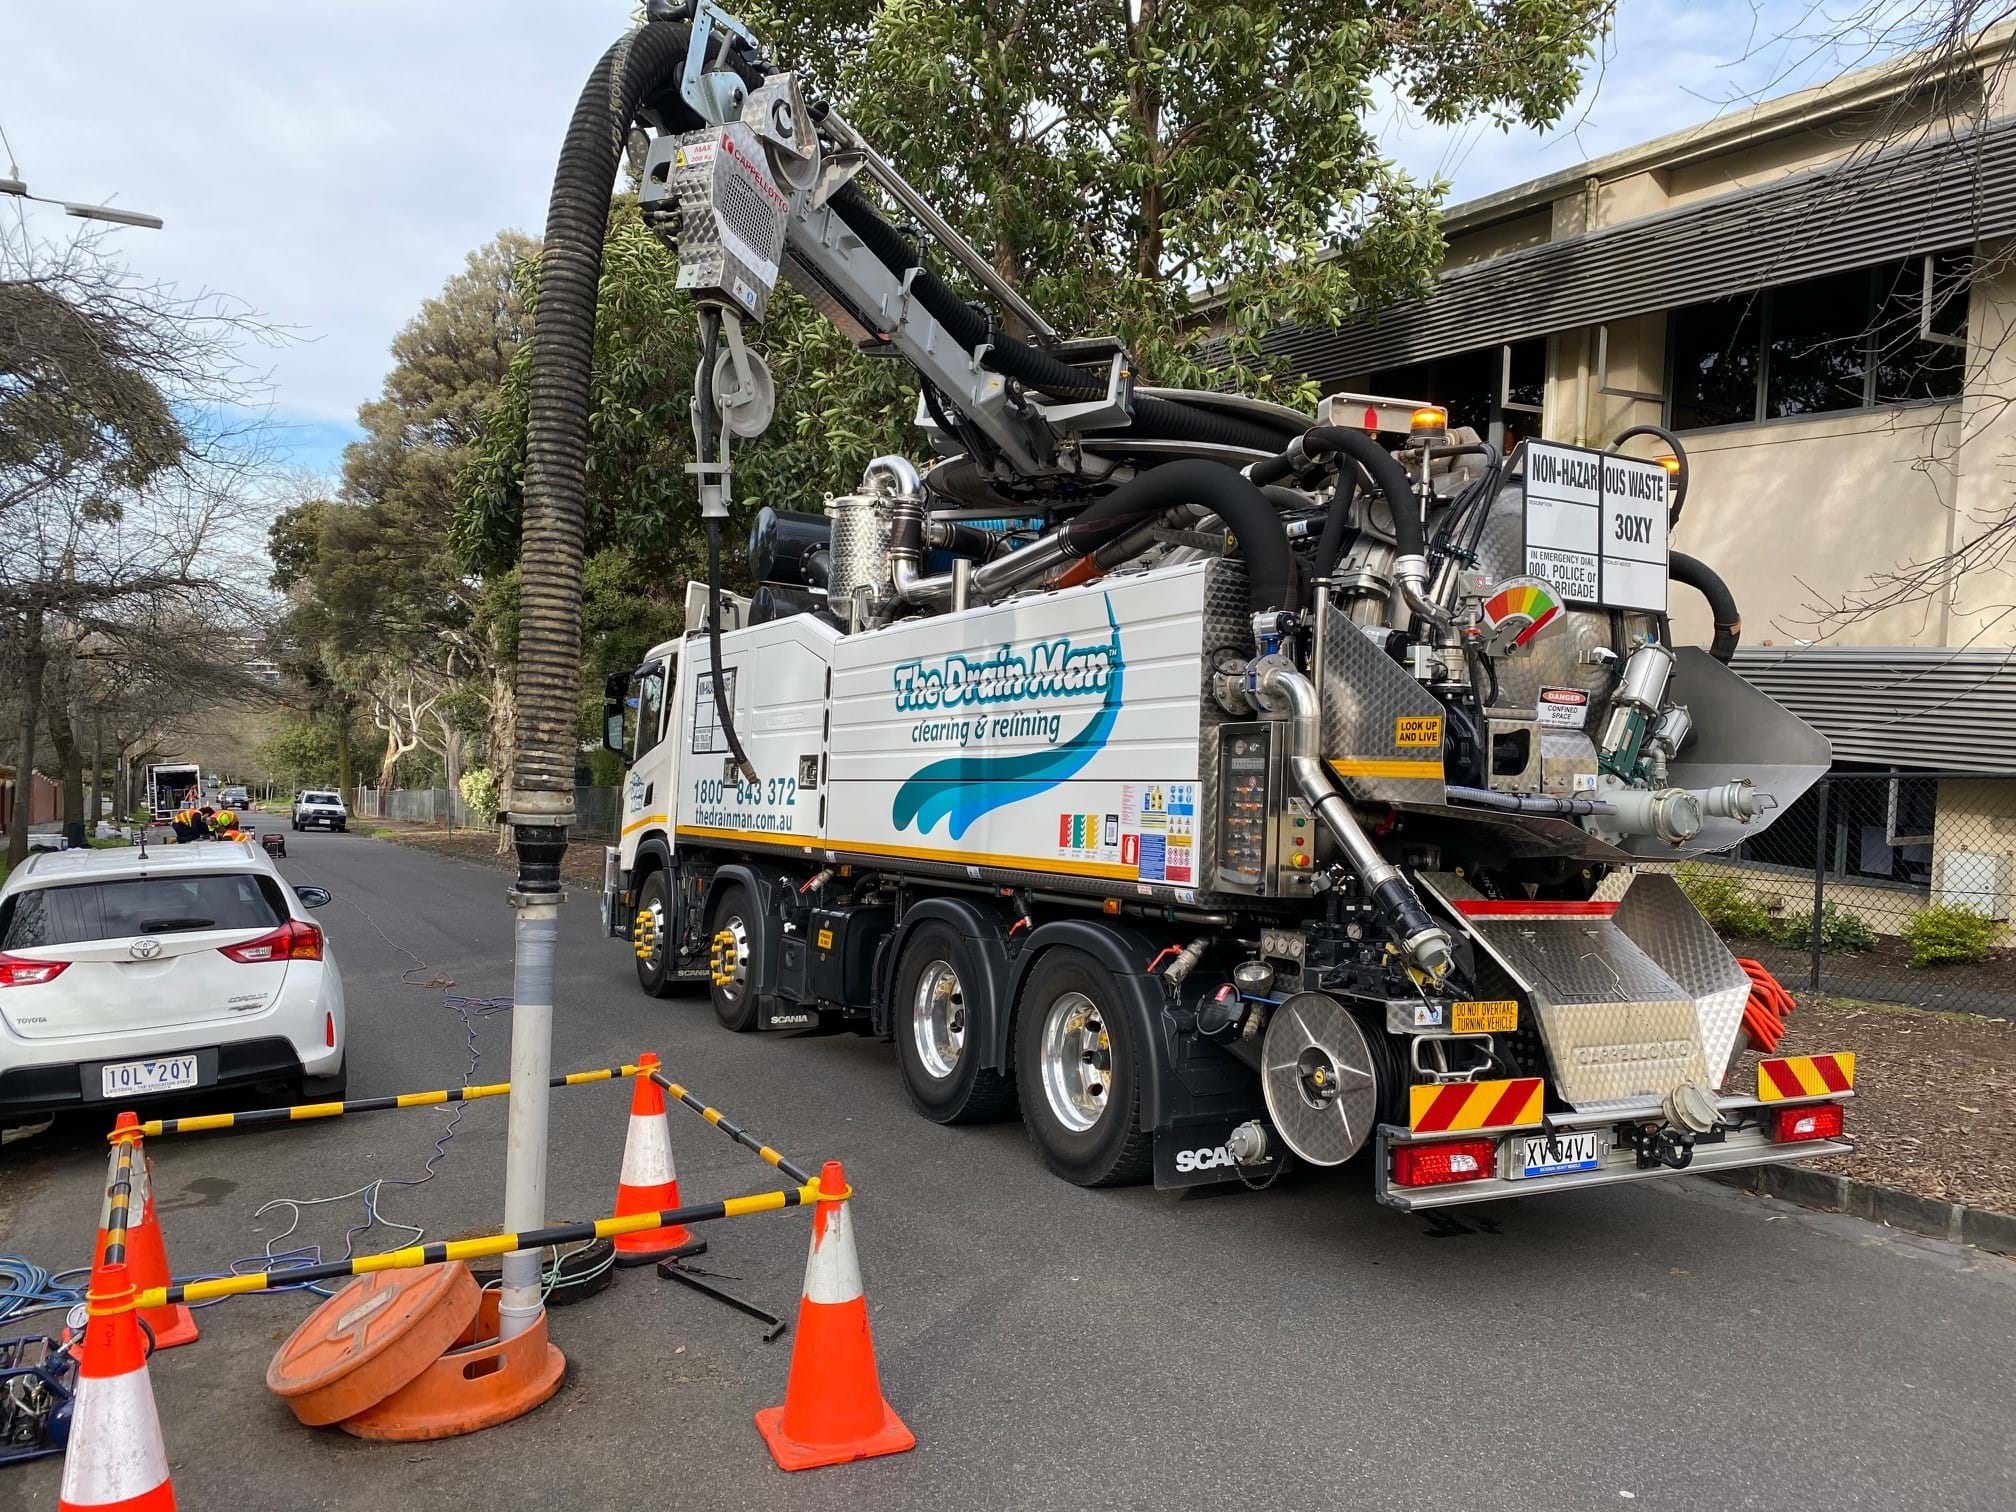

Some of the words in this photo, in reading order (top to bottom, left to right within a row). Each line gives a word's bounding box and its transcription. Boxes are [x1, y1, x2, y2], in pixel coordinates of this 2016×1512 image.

[694, 144, 712, 153] MAX
[734, 150, 789, 213] CAPPELLOTTO
[1532, 453, 1626, 496] NON-HAZAROUS
[1629, 471, 1663, 502] WASTE
[1530, 551, 1538, 560] IN
[1539, 552, 1579, 566] EMERGENCY
[1580, 558, 1595, 567] DIAL
[1552, 564, 1585, 582] POLICE
[1587, 571, 1596, 582] or
[894, 662, 942, 711] The
[943, 643, 1026, 707] Drain
[1025, 638, 1113, 698] Man
[1548, 692, 1581, 702] DANGER
[1547, 705, 1578, 713] CONFINED
[1551, 712, 1572, 720] SPACE
[912, 714, 970, 748] clearing
[974, 714, 988, 740] &
[992, 707, 1062, 744] relining
[1401, 721, 1424, 731] LOOK
[1425, 721, 1438, 731] UP
[1399, 732, 1417, 742] AND
[1418, 732, 1438, 742] LIVE
[695, 779, 723, 804] 1800
[736, 778, 761, 805] 843
[767, 777, 796, 805] 372
[695, 804, 793, 832] thedrainman.com.au
[677, 969, 710, 977] SCANIA
[1456, 1003, 1466, 1017] DO
[1467, 1002, 1480, 1017] NOT
[1481, 1001, 1515, 1016] OVERTAKE
[17, 1016, 48, 1025] TOYOTA
[770, 1015, 809, 1025] SCANIA
[1457, 1016, 1485, 1032] TURNING
[1487, 1015, 1513, 1030] VEHICLE
